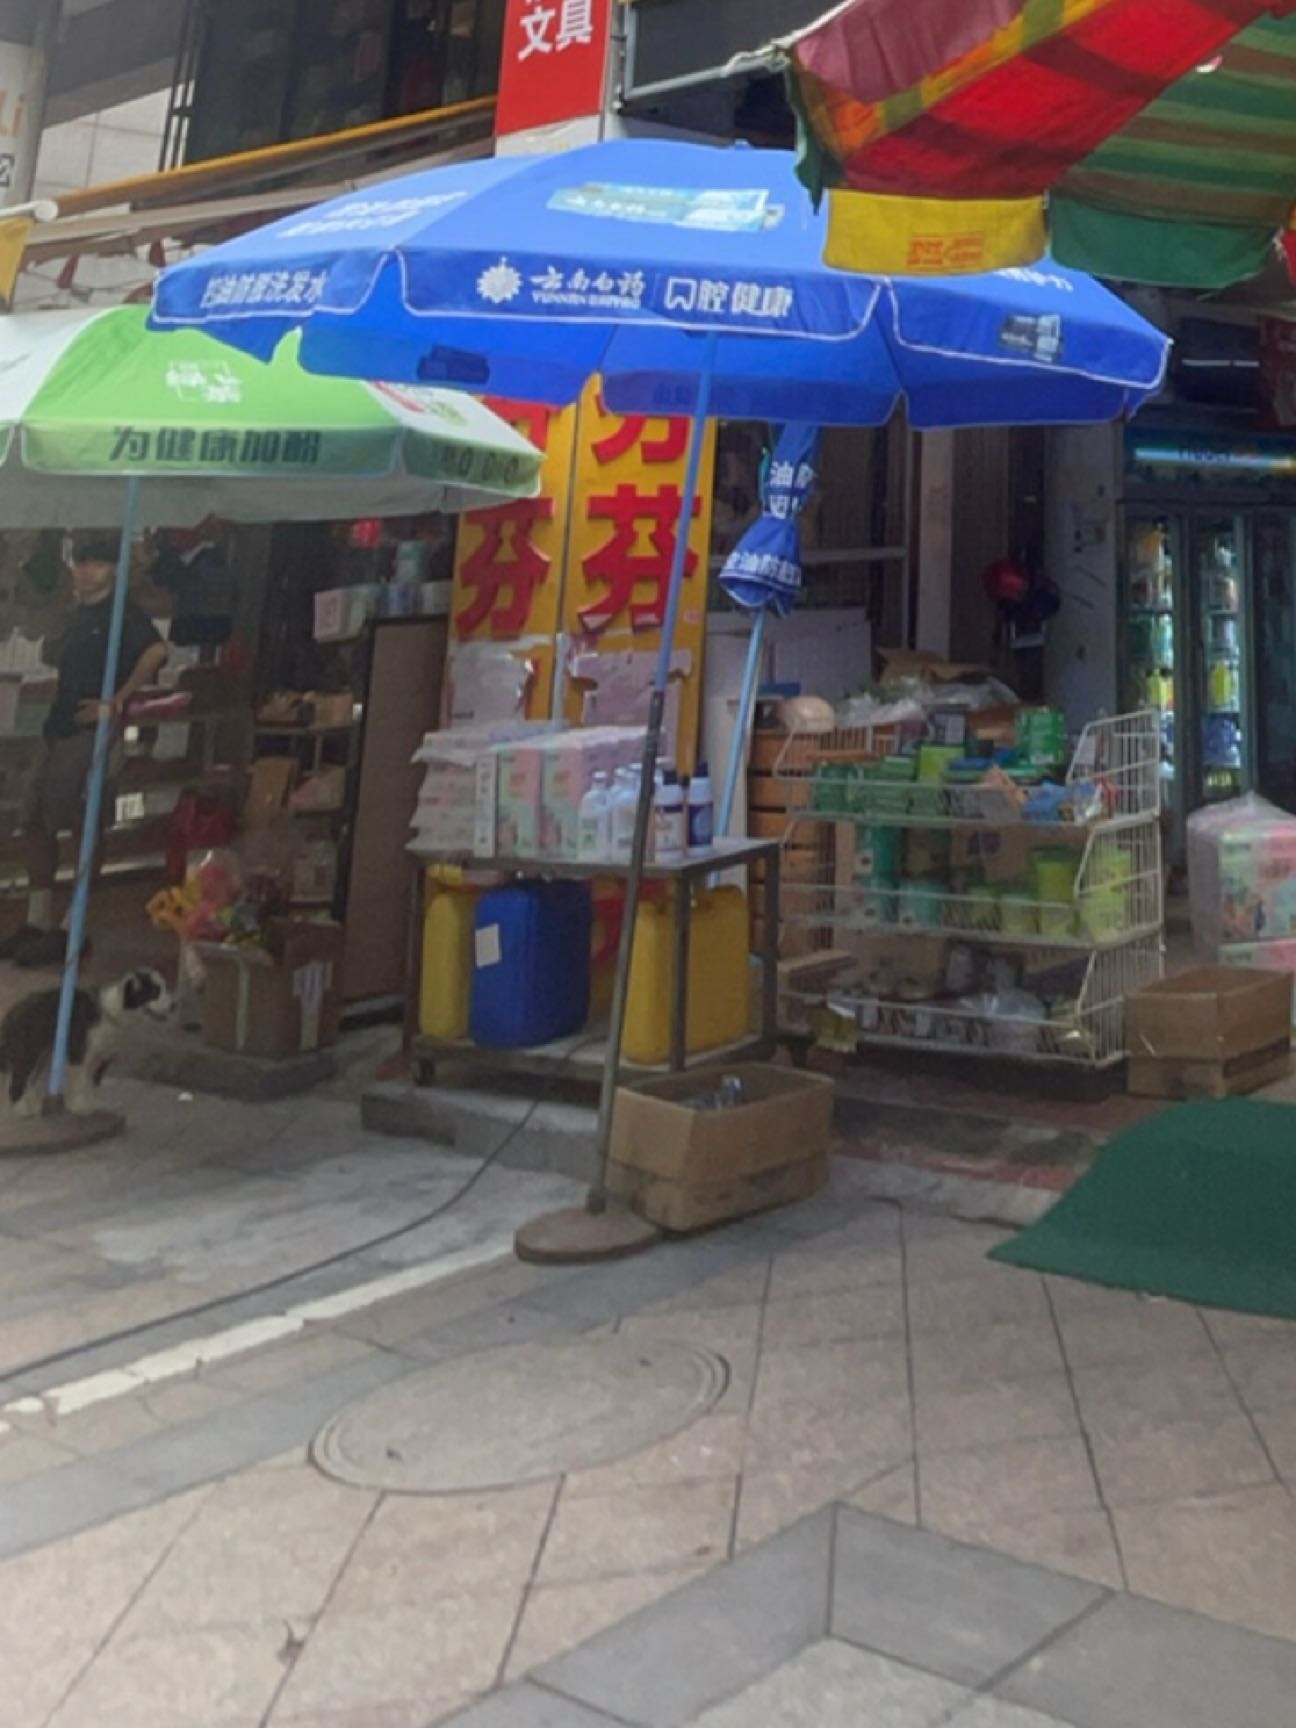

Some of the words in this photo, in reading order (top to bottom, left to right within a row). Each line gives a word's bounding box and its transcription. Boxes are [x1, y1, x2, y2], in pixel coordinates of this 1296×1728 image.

[530, 265, 646, 298] 云南白药
[664, 276, 793, 318] 口腔健康
